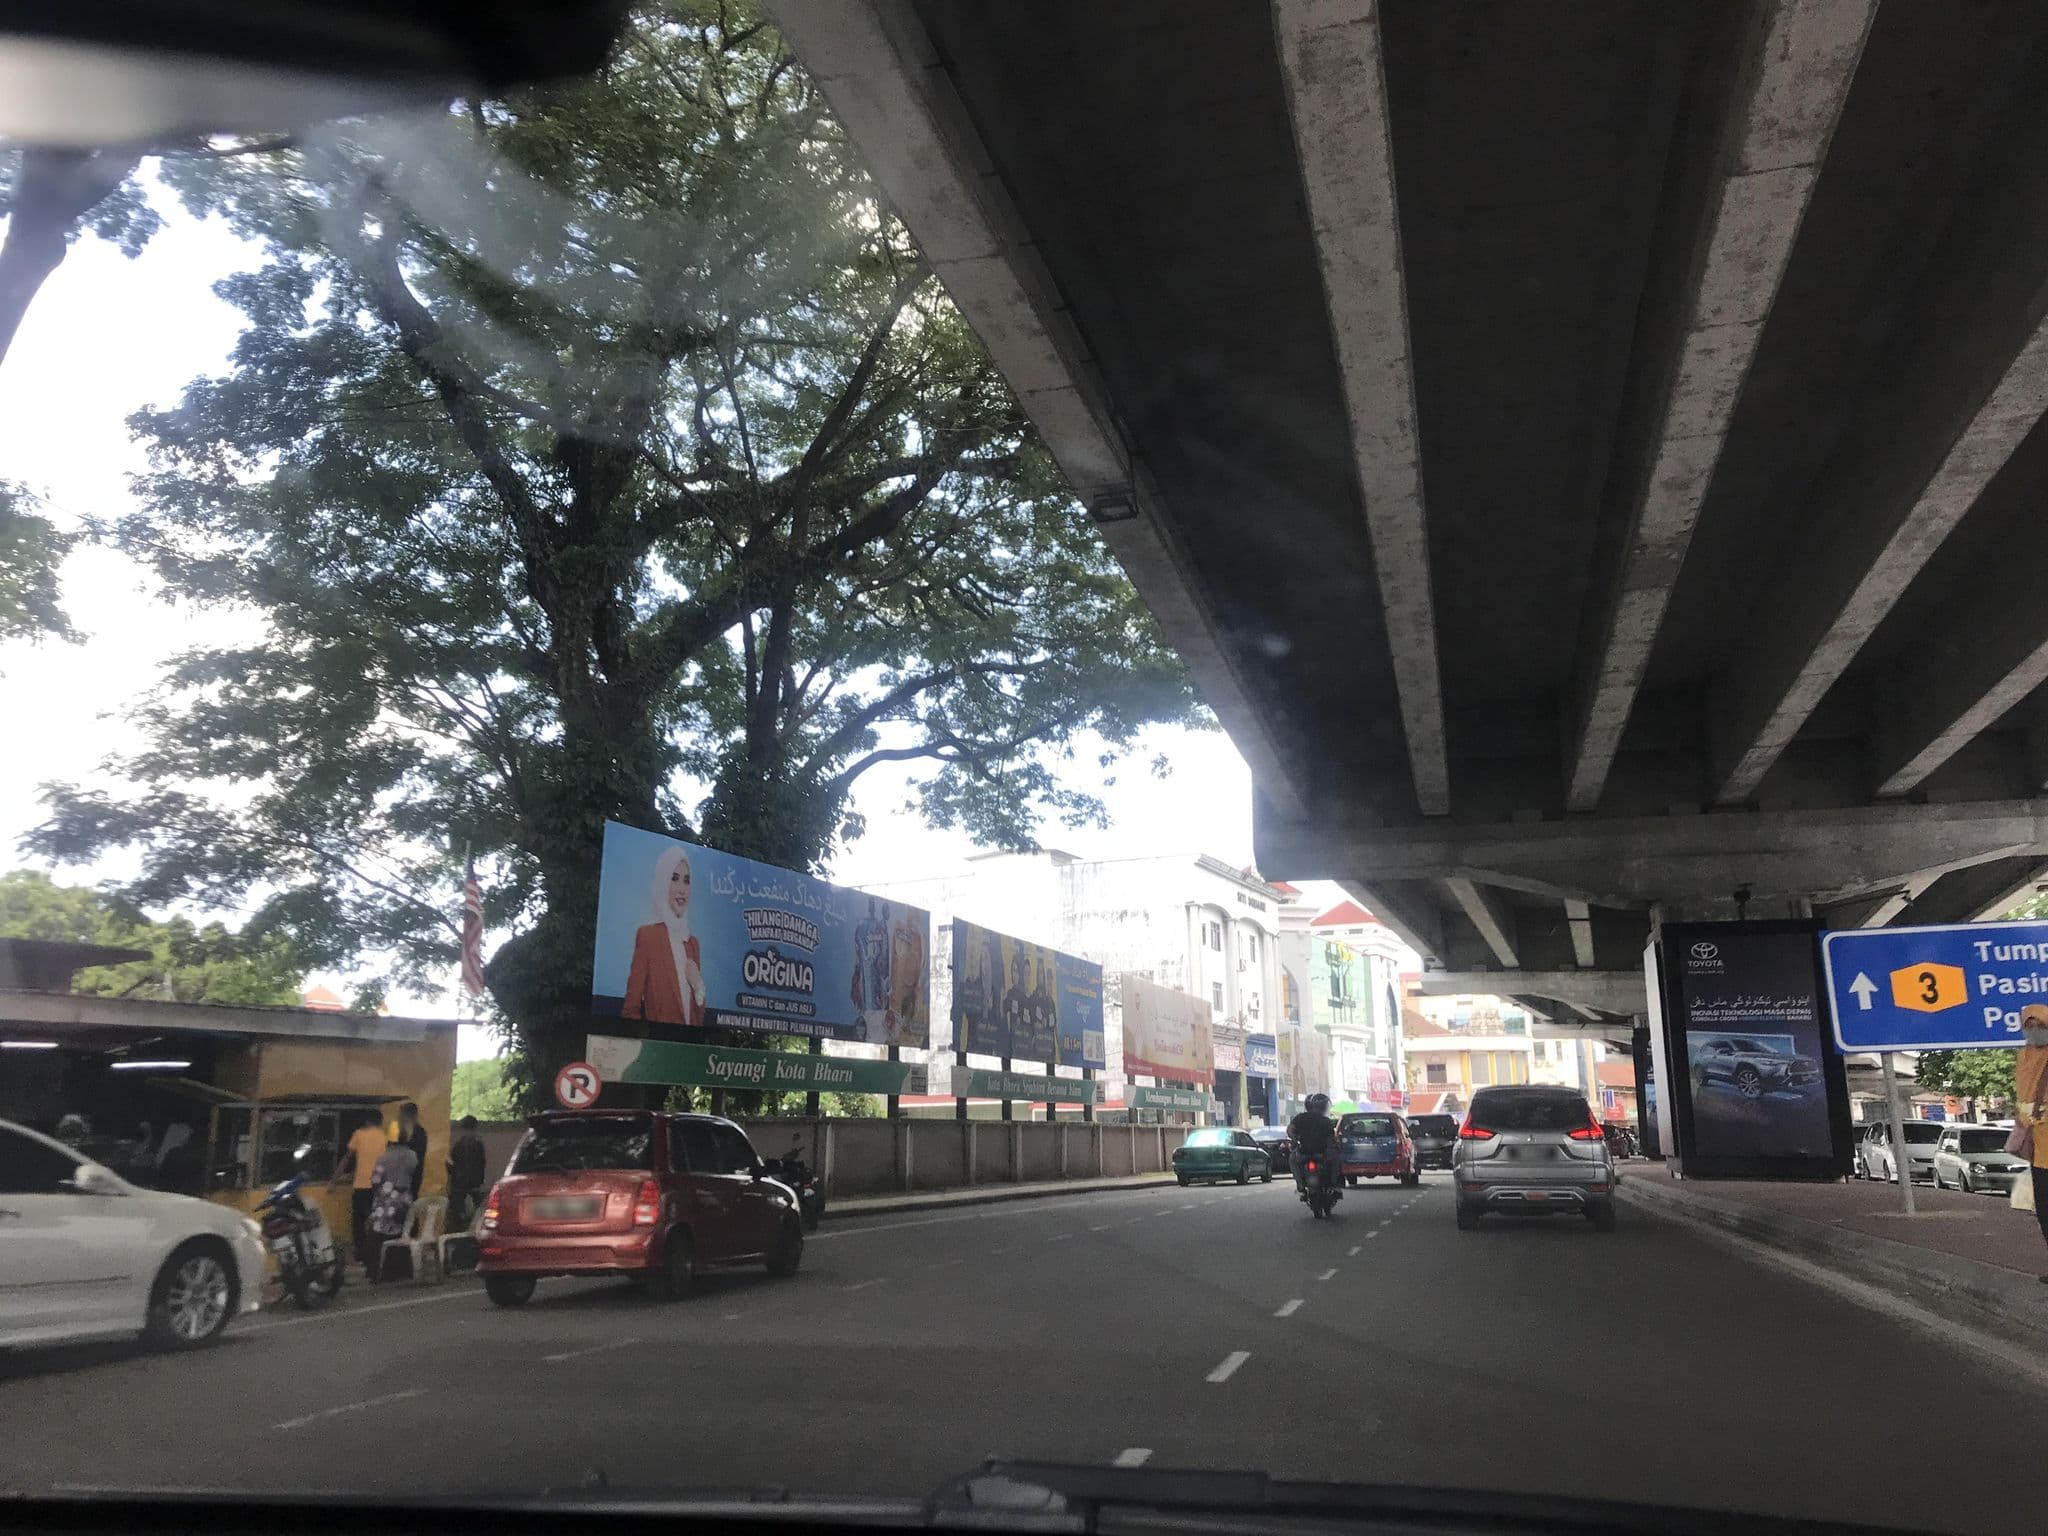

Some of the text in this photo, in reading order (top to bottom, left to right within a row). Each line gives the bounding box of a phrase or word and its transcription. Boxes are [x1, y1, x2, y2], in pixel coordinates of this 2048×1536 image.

[1919, 971, 1938, 1004] 3
[706, 1054, 853, 1082] Sayangi Kota Bharu
[570, 1074, 589, 1098] P
